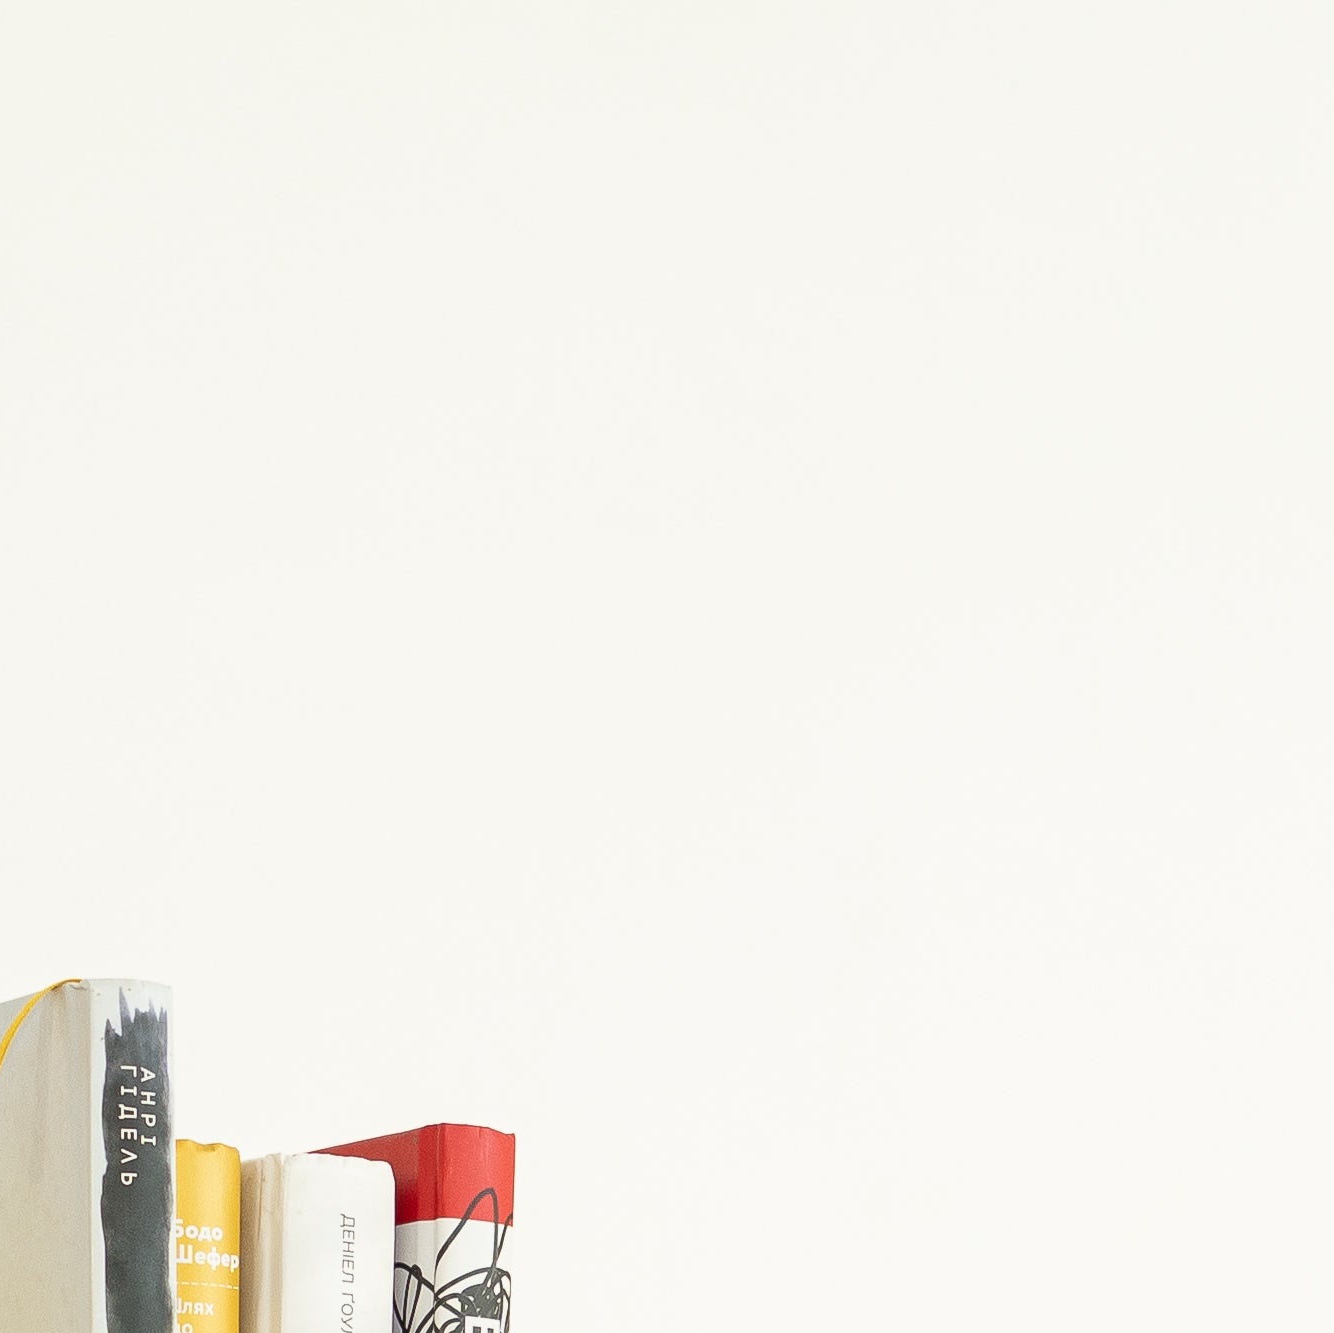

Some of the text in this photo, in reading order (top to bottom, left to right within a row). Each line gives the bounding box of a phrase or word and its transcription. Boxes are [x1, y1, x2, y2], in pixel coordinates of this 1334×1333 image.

[117, 1065, 138, 1186] ГІДЕЛЬ
[140, 1066, 157, 1147] АНРІ
[339, 1213, 356, 1284] ДЕНІЕЛ
